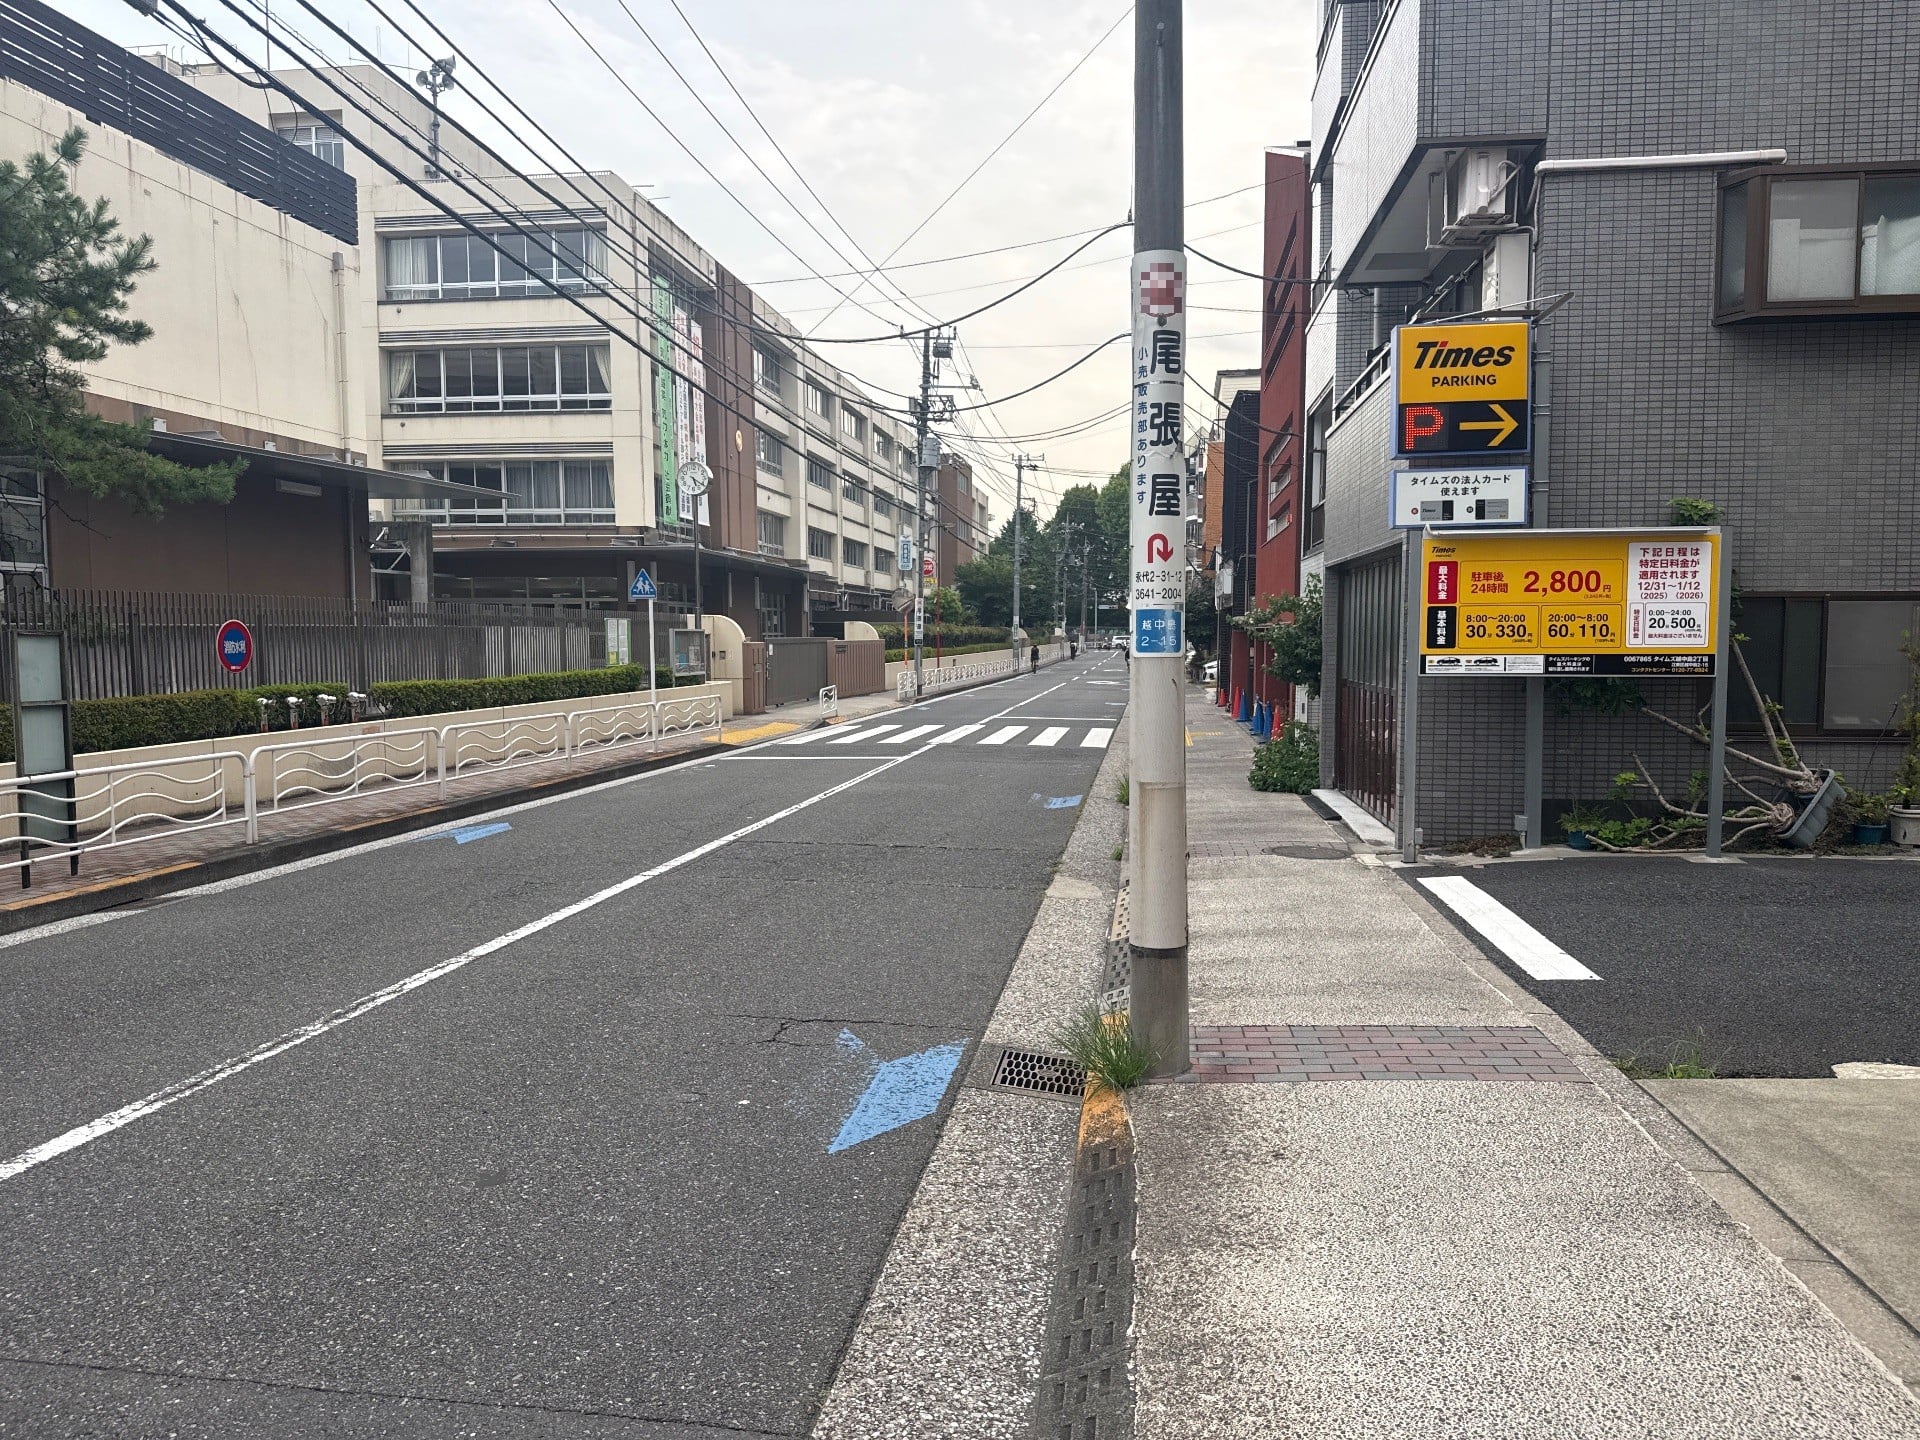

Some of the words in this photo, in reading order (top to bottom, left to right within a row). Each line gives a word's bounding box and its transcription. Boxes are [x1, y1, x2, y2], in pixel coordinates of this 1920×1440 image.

[1413, 341, 1516, 369] Times
[1431, 374, 1497, 387] PARKING
[1136, 346, 1149, 504] 小売販売部あります
[1149, 330, 1181, 517] 尾張屋
[1404, 406, 1444, 450] P
[1410, 474, 1512, 486] タイムズの法人カード
[1440, 487, 1480, 497] 使えます
[1431, 546, 1457, 554] Times
[1639, 547, 1701, 558] 下記日程は
[1639, 559, 1700, 569] 特定日料金が
[1470, 571, 1505, 583] 駐車後
[1638, 570, 1700, 580] 適用されます
[1438, 565, 1449, 600] 最大料金
[1470, 583, 1509, 594] 24時間
[1135, 588, 1182, 600] 3641-2004
[1640, 592, 1668, 600] (2025)
[1675, 592, 1704, 600] (2026)
[1437, 610, 1447, 645] 基本料金
